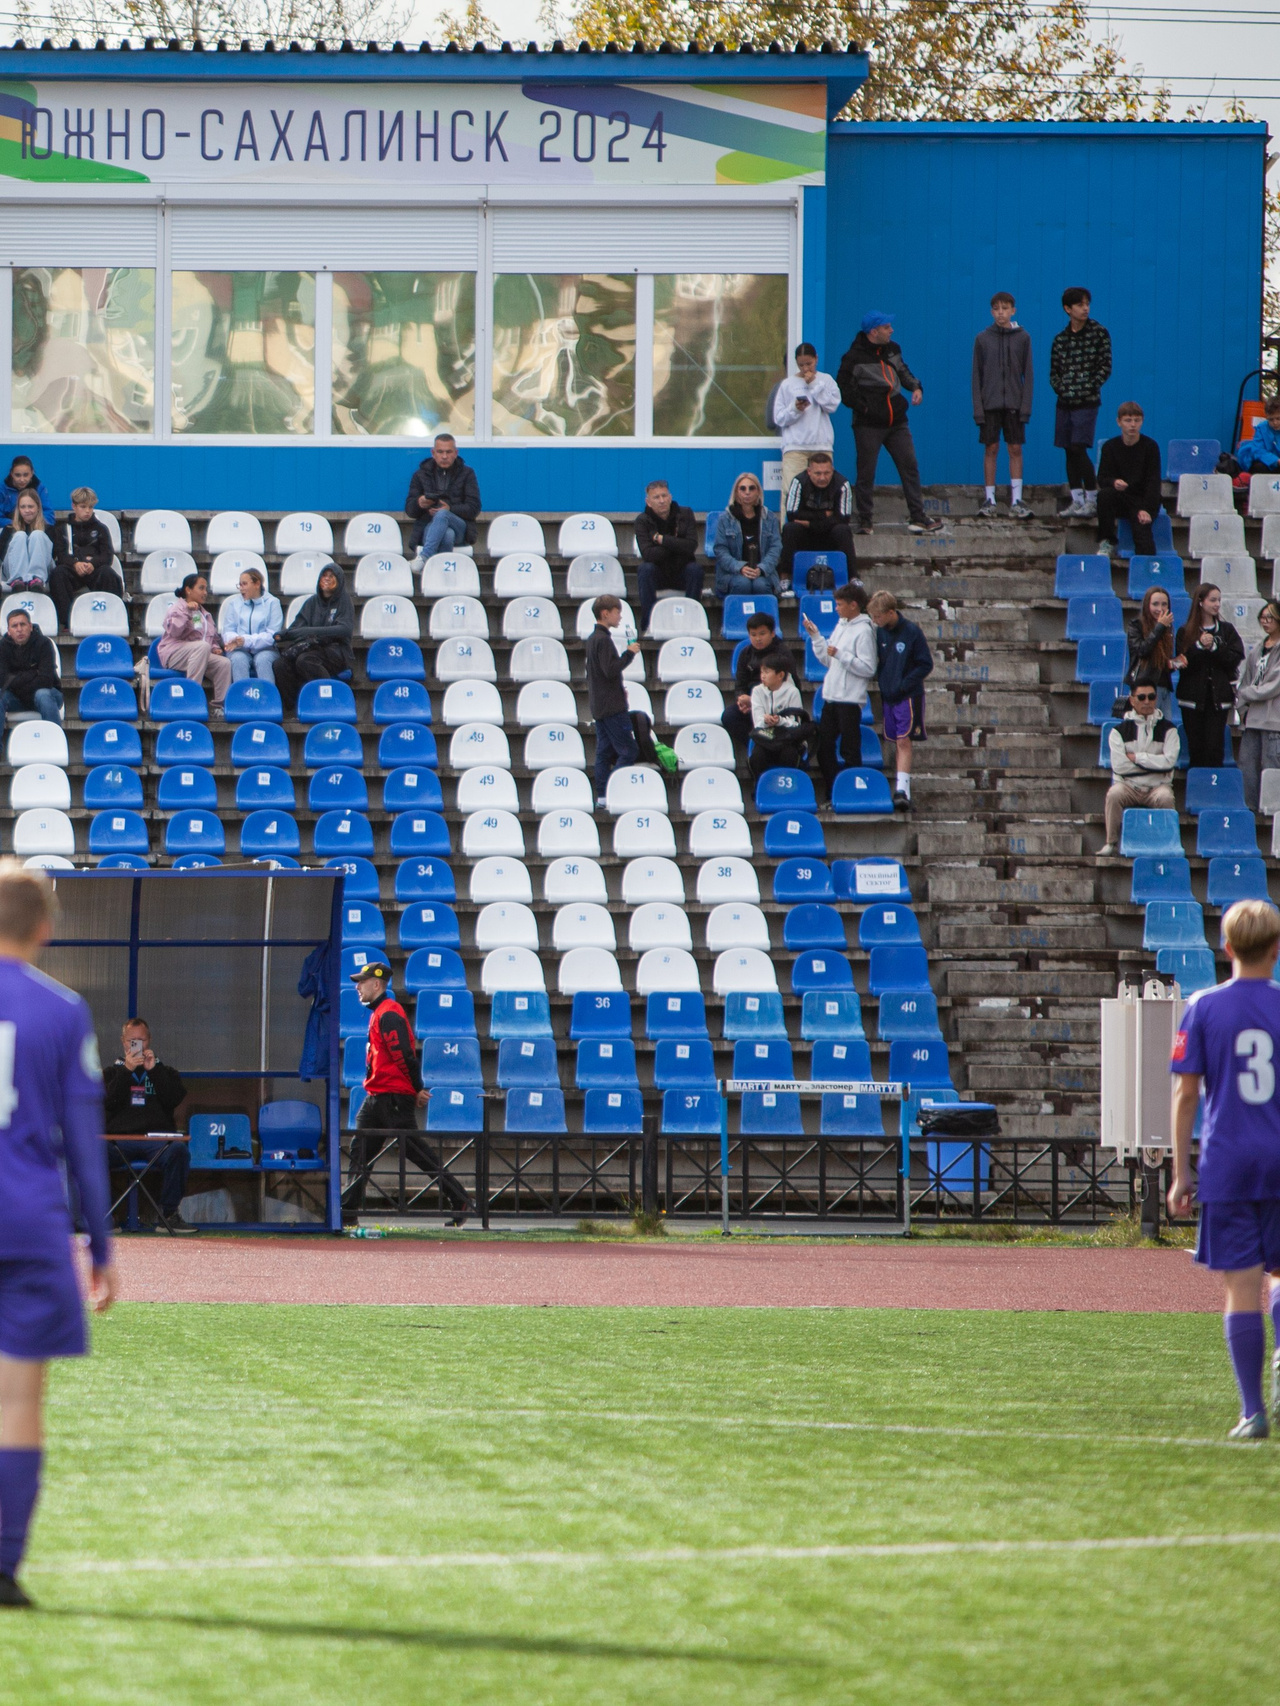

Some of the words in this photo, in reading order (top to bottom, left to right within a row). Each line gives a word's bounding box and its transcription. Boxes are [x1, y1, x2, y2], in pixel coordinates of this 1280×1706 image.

[21, 108, 510, 164] ЮЖНО-САХАЛИНСК
[539, 109, 669, 164] 2024
[1192, 446, 1198, 456] 3
[1203, 481, 1208, 490] 3
[300, 522, 312, 532] 19
[368, 524, 381, 533] 20
[581, 521, 595, 530] 23
[1214, 521, 1219, 531] 3
[162, 558, 174, 568] 17
[379, 561, 391, 570] 20
[444, 562, 456, 571] 21
[518, 562, 531, 572] 22
[1080, 561, 1085, 571] 1
[1153, 562, 1159, 572] 2
[1225, 563, 1230, 573] 3
[92, 601, 106, 611] 26
[453, 606, 465, 616] 31
[1091, 604, 1096, 614] 1
[1237, 606, 1243, 616] 3
[97, 642, 111, 653] 29
[389, 646, 402, 656] 33
[681, 647, 694, 656] 37
[1102, 645, 1107, 655] 1
[101, 684, 116, 694] 44
[245, 688, 260, 699] 46
[394, 687, 409, 697] 48
[688, 688, 702, 698] 52
[1114, 687, 1119, 698] 1
[176, 729, 192, 741] 45
[325, 729, 341, 740] 47
[400, 730, 414, 740] 48
[549, 731, 564, 741] 50
[693, 733, 706, 743] 52
[329, 774, 342, 784] 47
[480, 775, 494, 785] 49
[555, 777, 568, 787] 50
[631, 774, 644, 783] 51
[778, 776, 792, 788] 53
[1212, 775, 1217, 785] 2
[484, 817, 497, 828] 49
[560, 818, 572, 827] 50
[637, 818, 649, 827] 51
[713, 819, 726, 828] 52
[1148, 814, 1153, 825] 1
[1224, 817, 1229, 827] 2
[418, 865, 433, 876] 34
[565, 865, 578, 874] 36
[718, 867, 731, 877] 38
[797, 869, 811, 879] 39
[1157, 864, 1164, 874] 1
[1234, 864, 1240, 875] 2
[1171, 907, 1176, 917] 1
[1182, 954, 1186, 965] 1
[596, 997, 610, 1008] 36
[901, 1002, 916, 1012] 40
[443, 1043, 458, 1055] 34
[913, 1050, 928, 1060] 40
[1235, 1029, 1275, 1106] 3
[811, 1083, 853, 1091] эластомер
[686, 1096, 700, 1108] 37
[210, 1123, 225, 1135] 20
